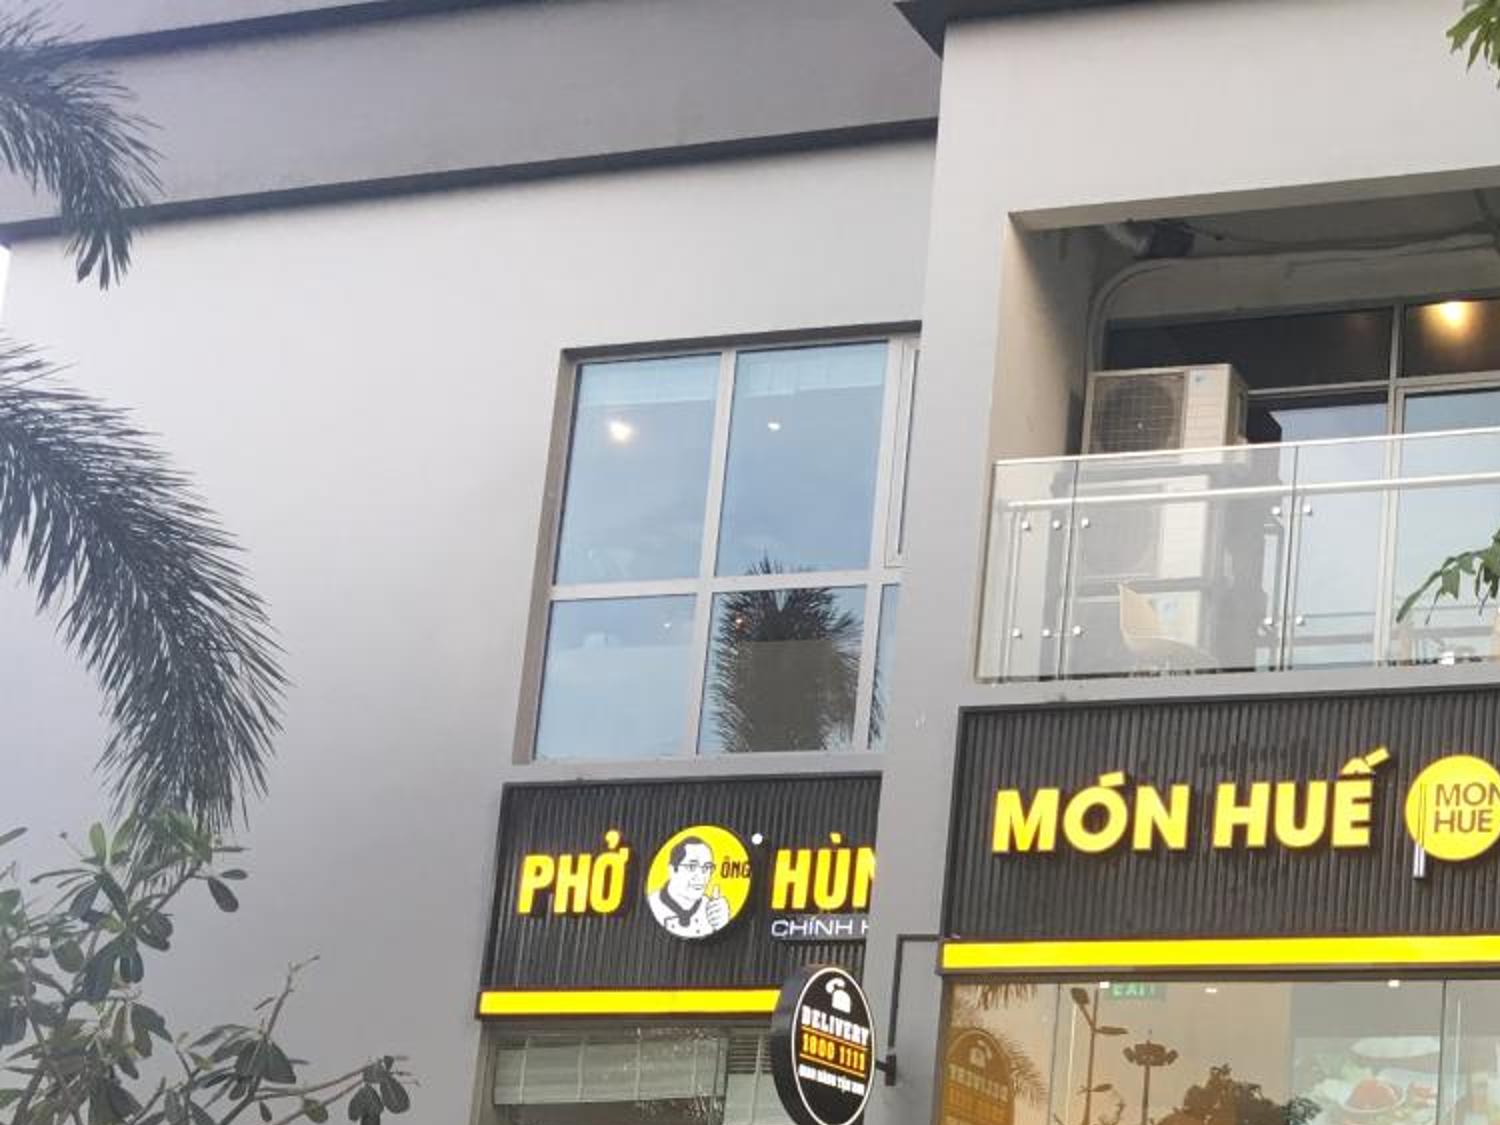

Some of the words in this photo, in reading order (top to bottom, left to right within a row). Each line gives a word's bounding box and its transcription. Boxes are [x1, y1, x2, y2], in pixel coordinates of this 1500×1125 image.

[991, 771, 1189, 854] MÓN
[1212, 745, 1391, 848] HUẾ
[1433, 809, 1494, 835] HUE
[517, 829, 630, 915] PHỞ
[771, 917, 854, 937] CHÍNH
[802, 1005, 869, 1046] DELIVERY
[839, 1045, 865, 1071] 1111
